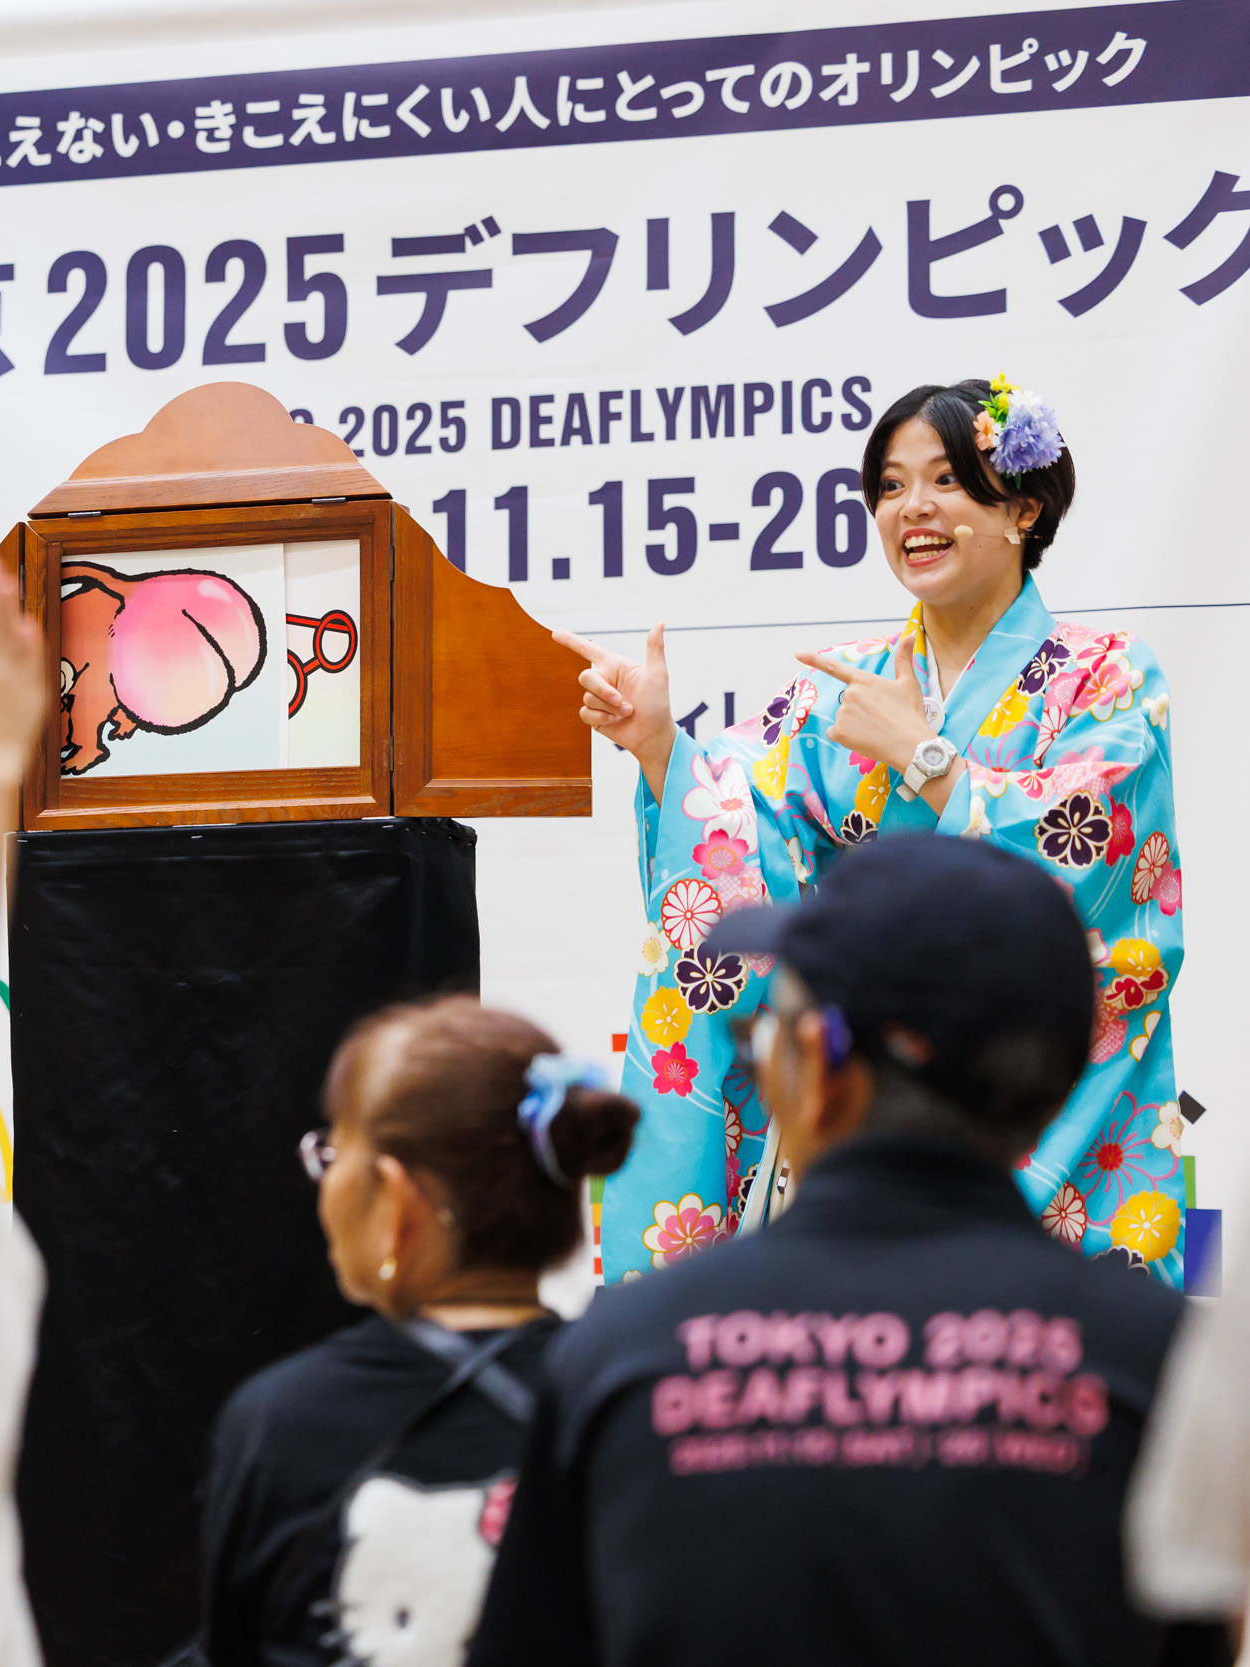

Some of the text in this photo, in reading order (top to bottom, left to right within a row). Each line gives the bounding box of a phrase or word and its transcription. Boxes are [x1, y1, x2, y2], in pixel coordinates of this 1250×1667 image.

[338, 376, 872, 458] 2025 DEAFLYMPICS
[432, 468, 867, 583] 11.15-26
[677, 1310, 910, 1369] TOKYO
